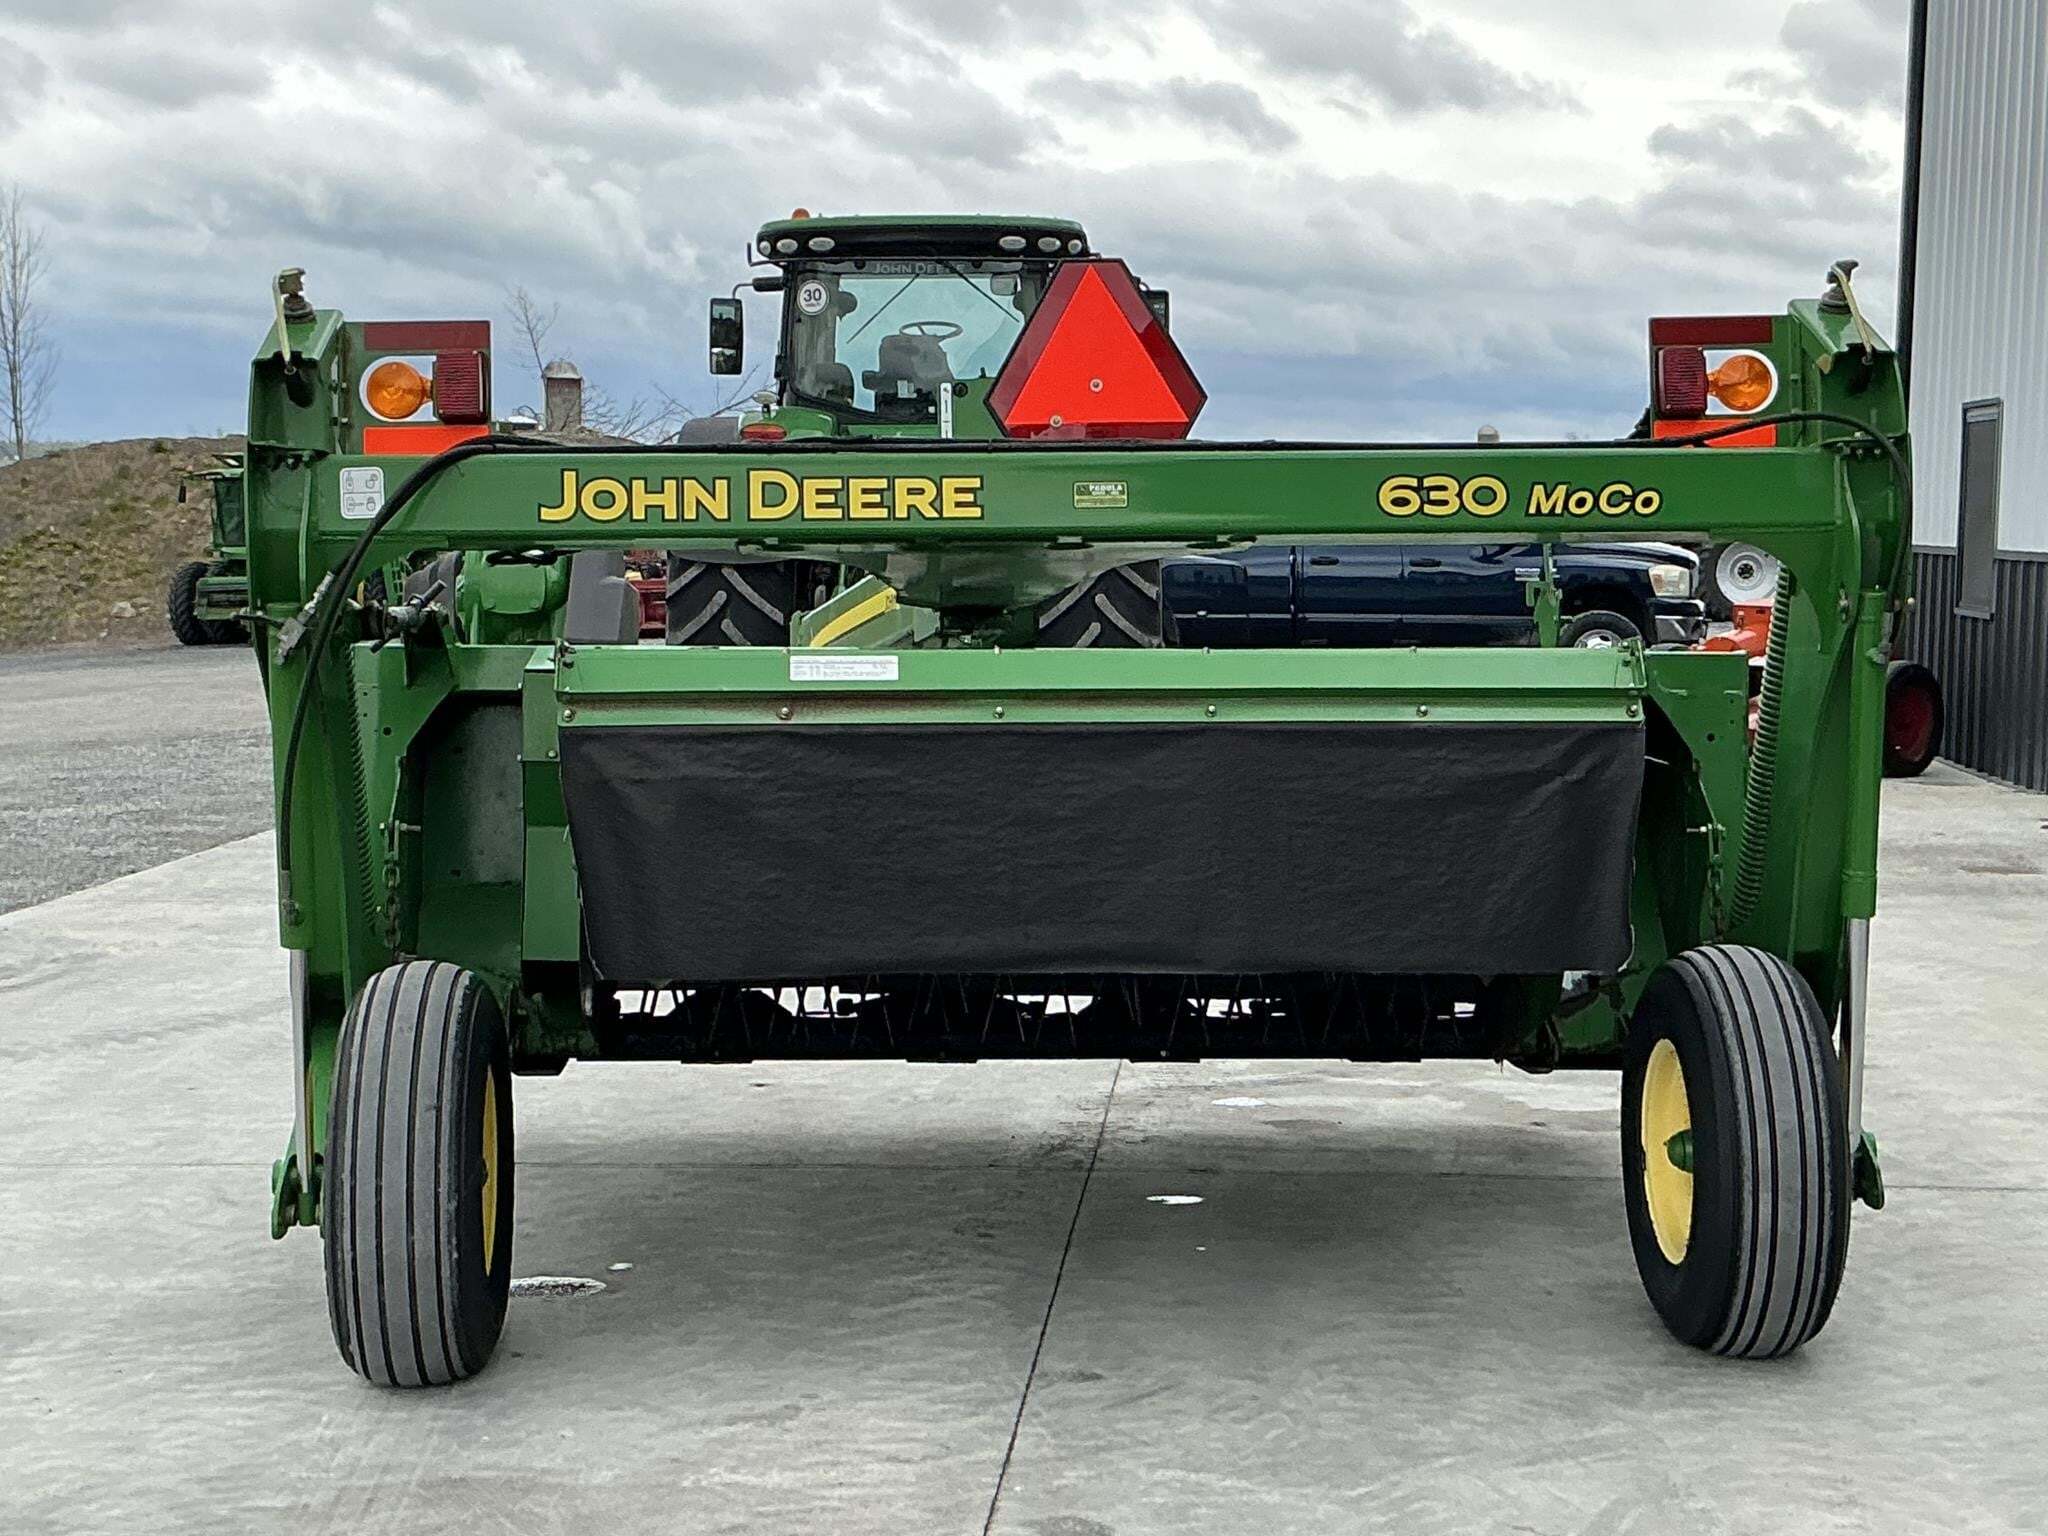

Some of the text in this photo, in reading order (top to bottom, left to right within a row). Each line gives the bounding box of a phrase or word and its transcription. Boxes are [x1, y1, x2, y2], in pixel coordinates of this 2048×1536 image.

[872, 263, 912, 274] JOHN
[803, 288, 822, 302] 30
[538, 467, 984, 522] JOHN DEERE
[1377, 473, 1662, 517] 630 MoCo
